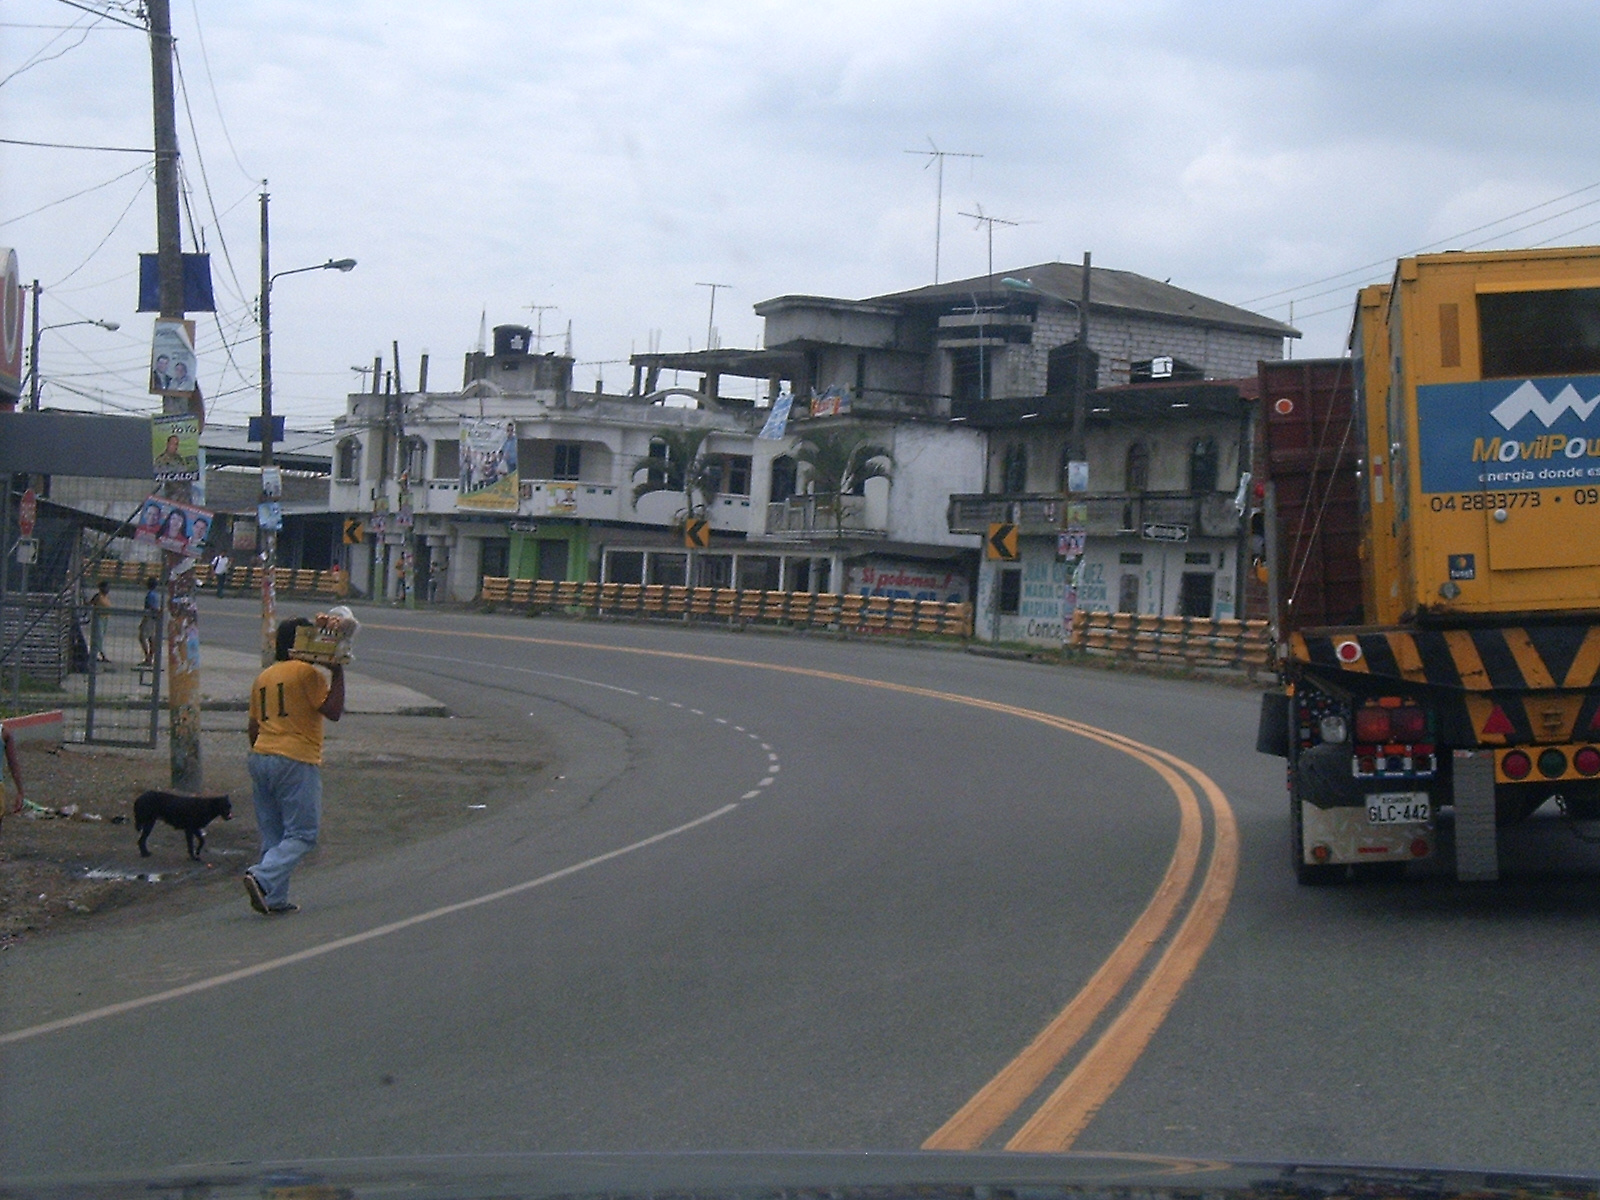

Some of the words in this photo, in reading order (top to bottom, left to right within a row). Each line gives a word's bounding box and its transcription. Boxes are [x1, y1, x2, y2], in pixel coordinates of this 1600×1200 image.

[155, 472, 198, 482] ALCALDE
[1538, 467, 1583, 479] donde
[1431, 496, 1456, 512] 04
[1461, 491, 1541, 511] 2833773
[1574, 488, 1598, 505] 09
[259, 682, 289, 722] 11
[1368, 804, 1428, 822] GLC-442
